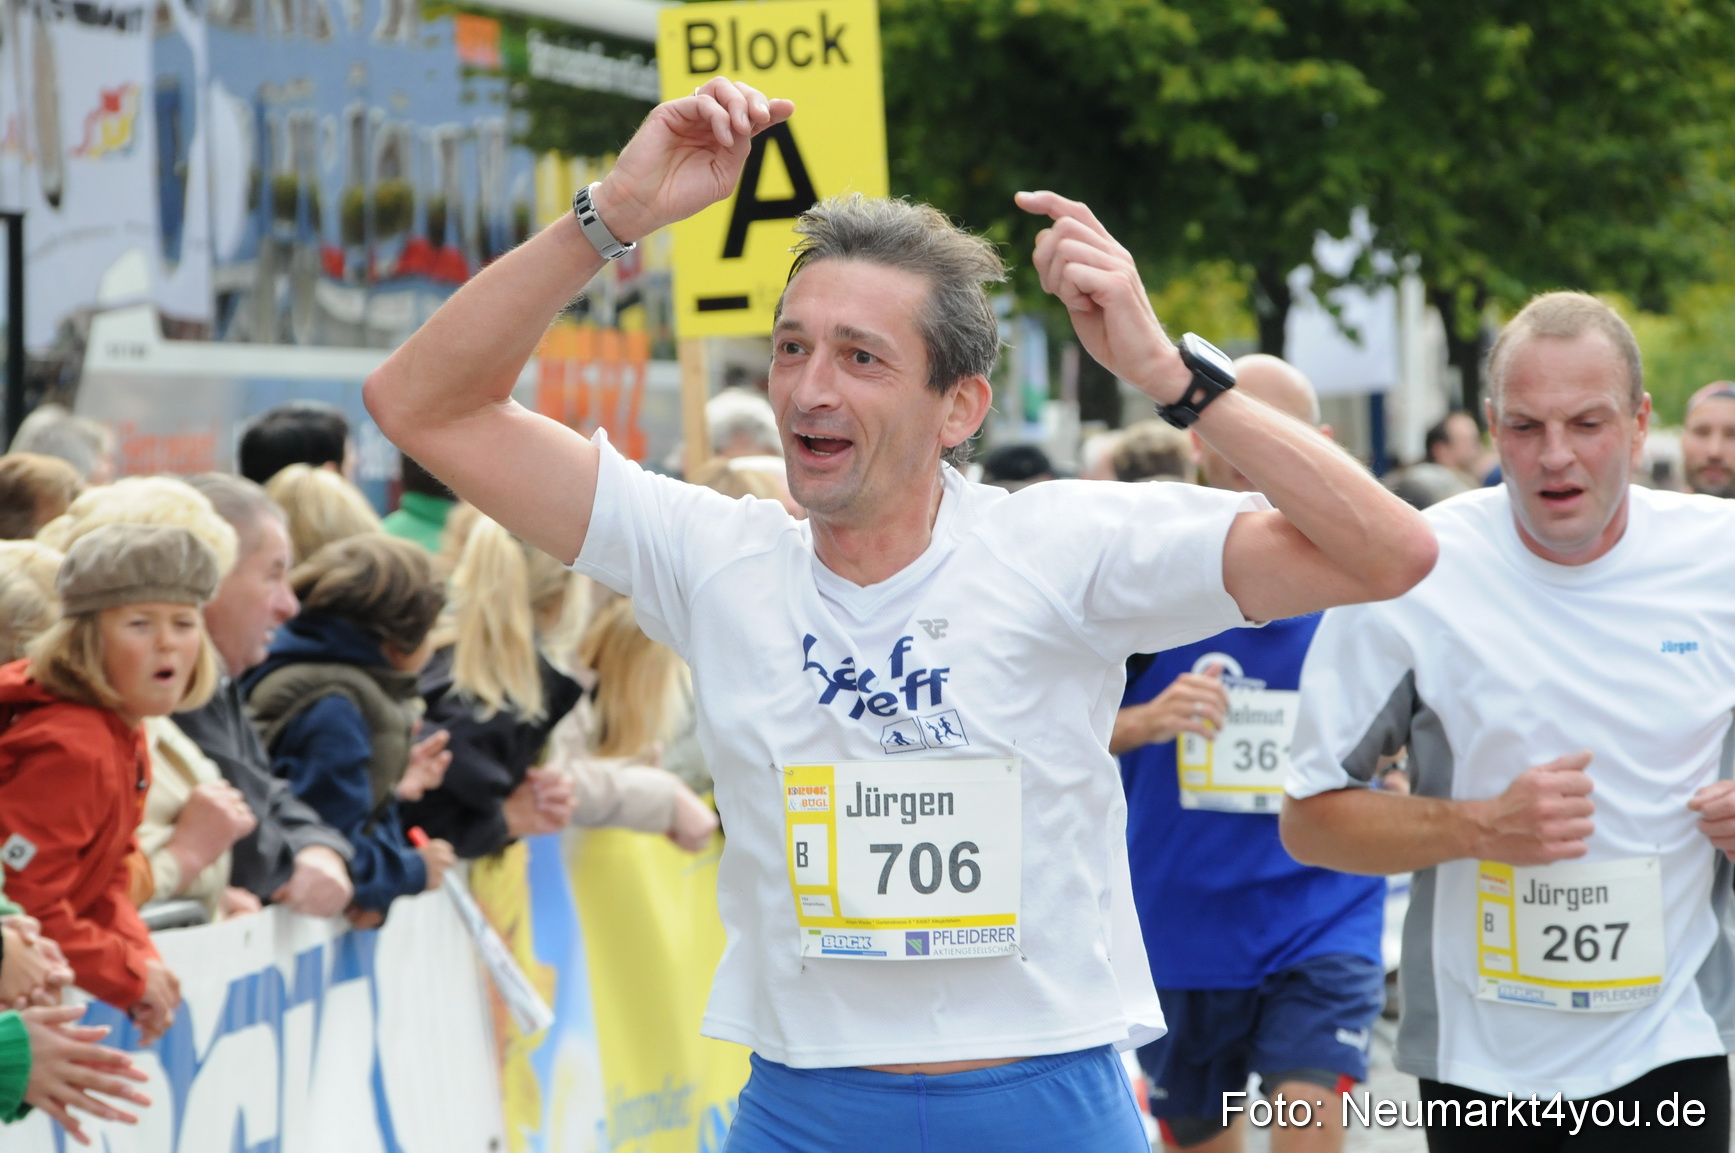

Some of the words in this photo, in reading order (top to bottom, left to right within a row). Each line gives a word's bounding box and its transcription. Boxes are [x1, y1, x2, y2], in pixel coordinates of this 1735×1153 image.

[686, 12, 850, 74] Block
[720, 118, 822, 258] A
[1233, 740, 1291, 771] 36
[846, 781, 954, 824] Jürgen
[796, 842, 808, 868] B
[869, 841, 981, 895] 706
[1523, 878, 1608, 911] Jürgen
[933, 927, 1016, 945] PFLEIDERER
[1484, 912, 1494, 932] B
[821, 935, 872, 949] BOCK
[1542, 922, 1630, 963] 267
